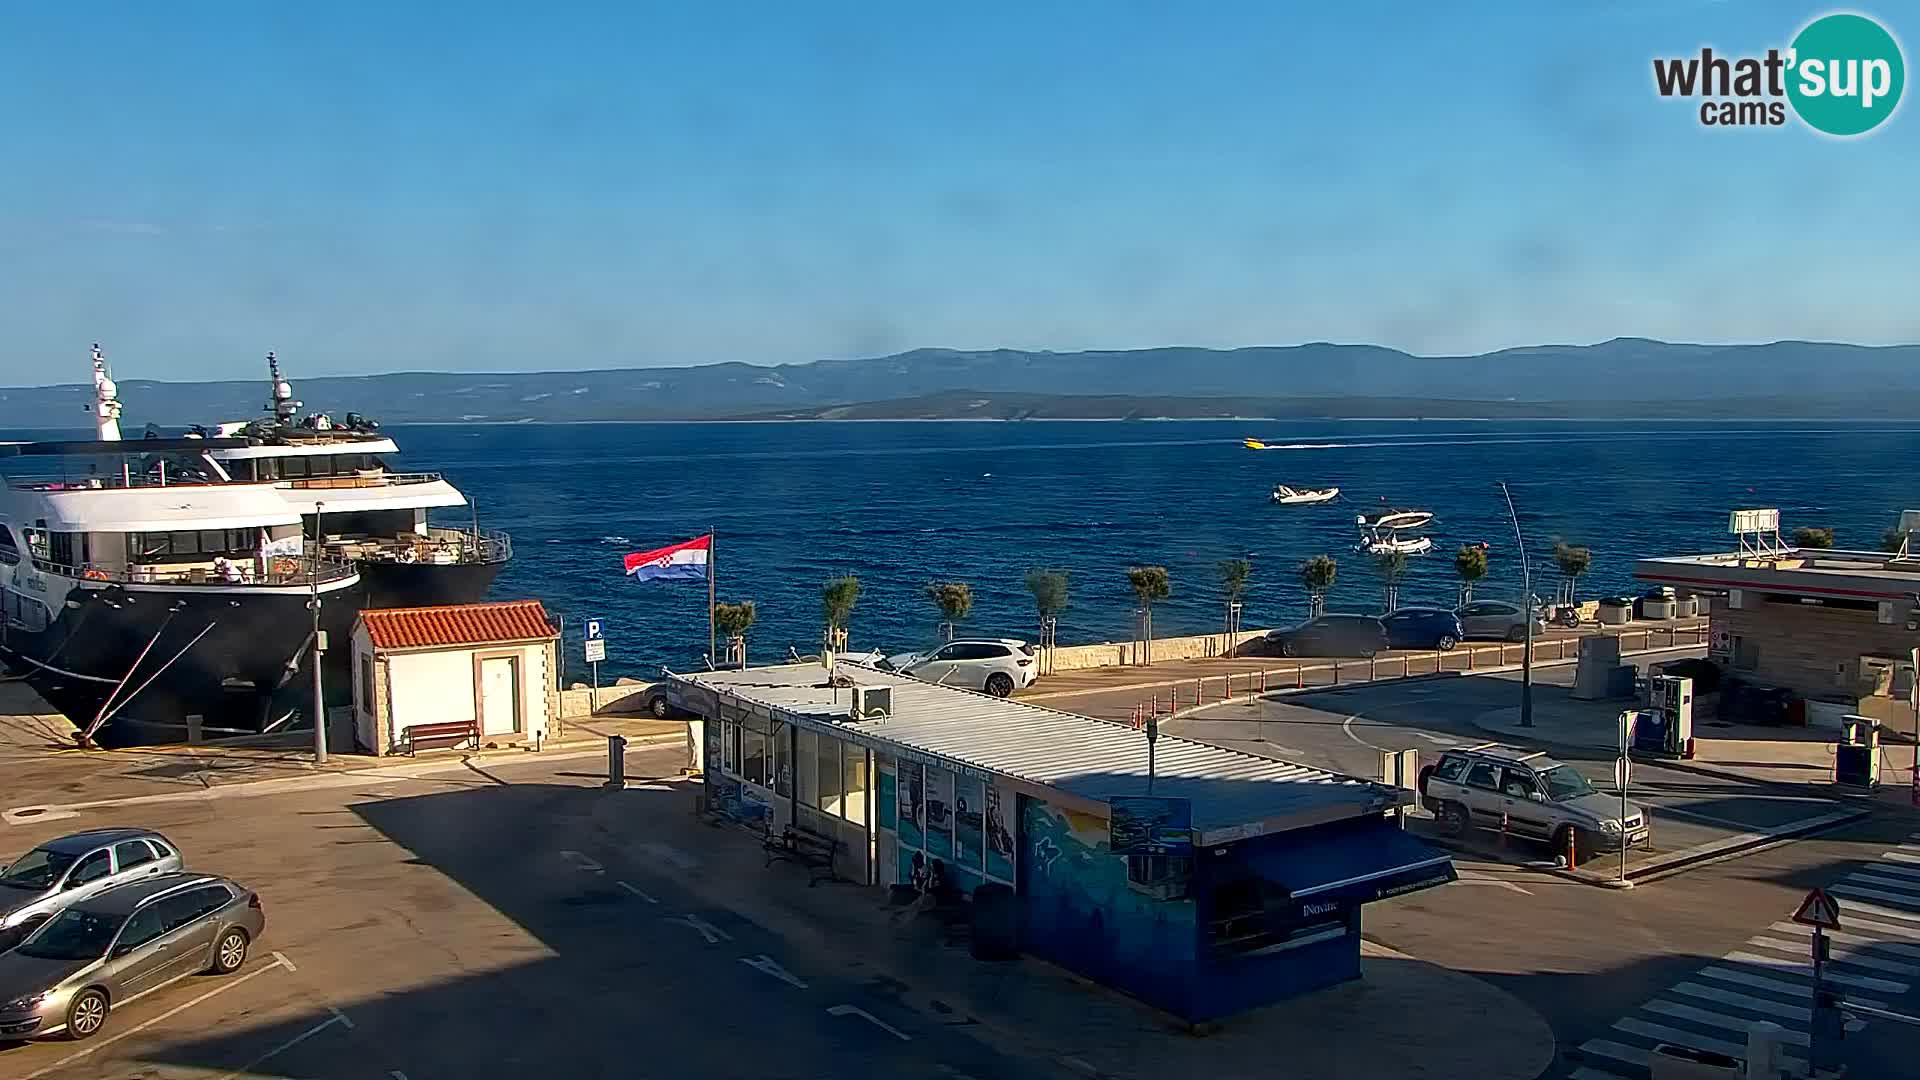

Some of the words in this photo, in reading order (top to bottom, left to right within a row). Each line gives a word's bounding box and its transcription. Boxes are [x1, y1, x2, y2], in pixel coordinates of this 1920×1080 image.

[589, 621, 600, 639] P
[940, 759, 964, 773] TICKET
[965, 766, 990, 781] OFFICE
